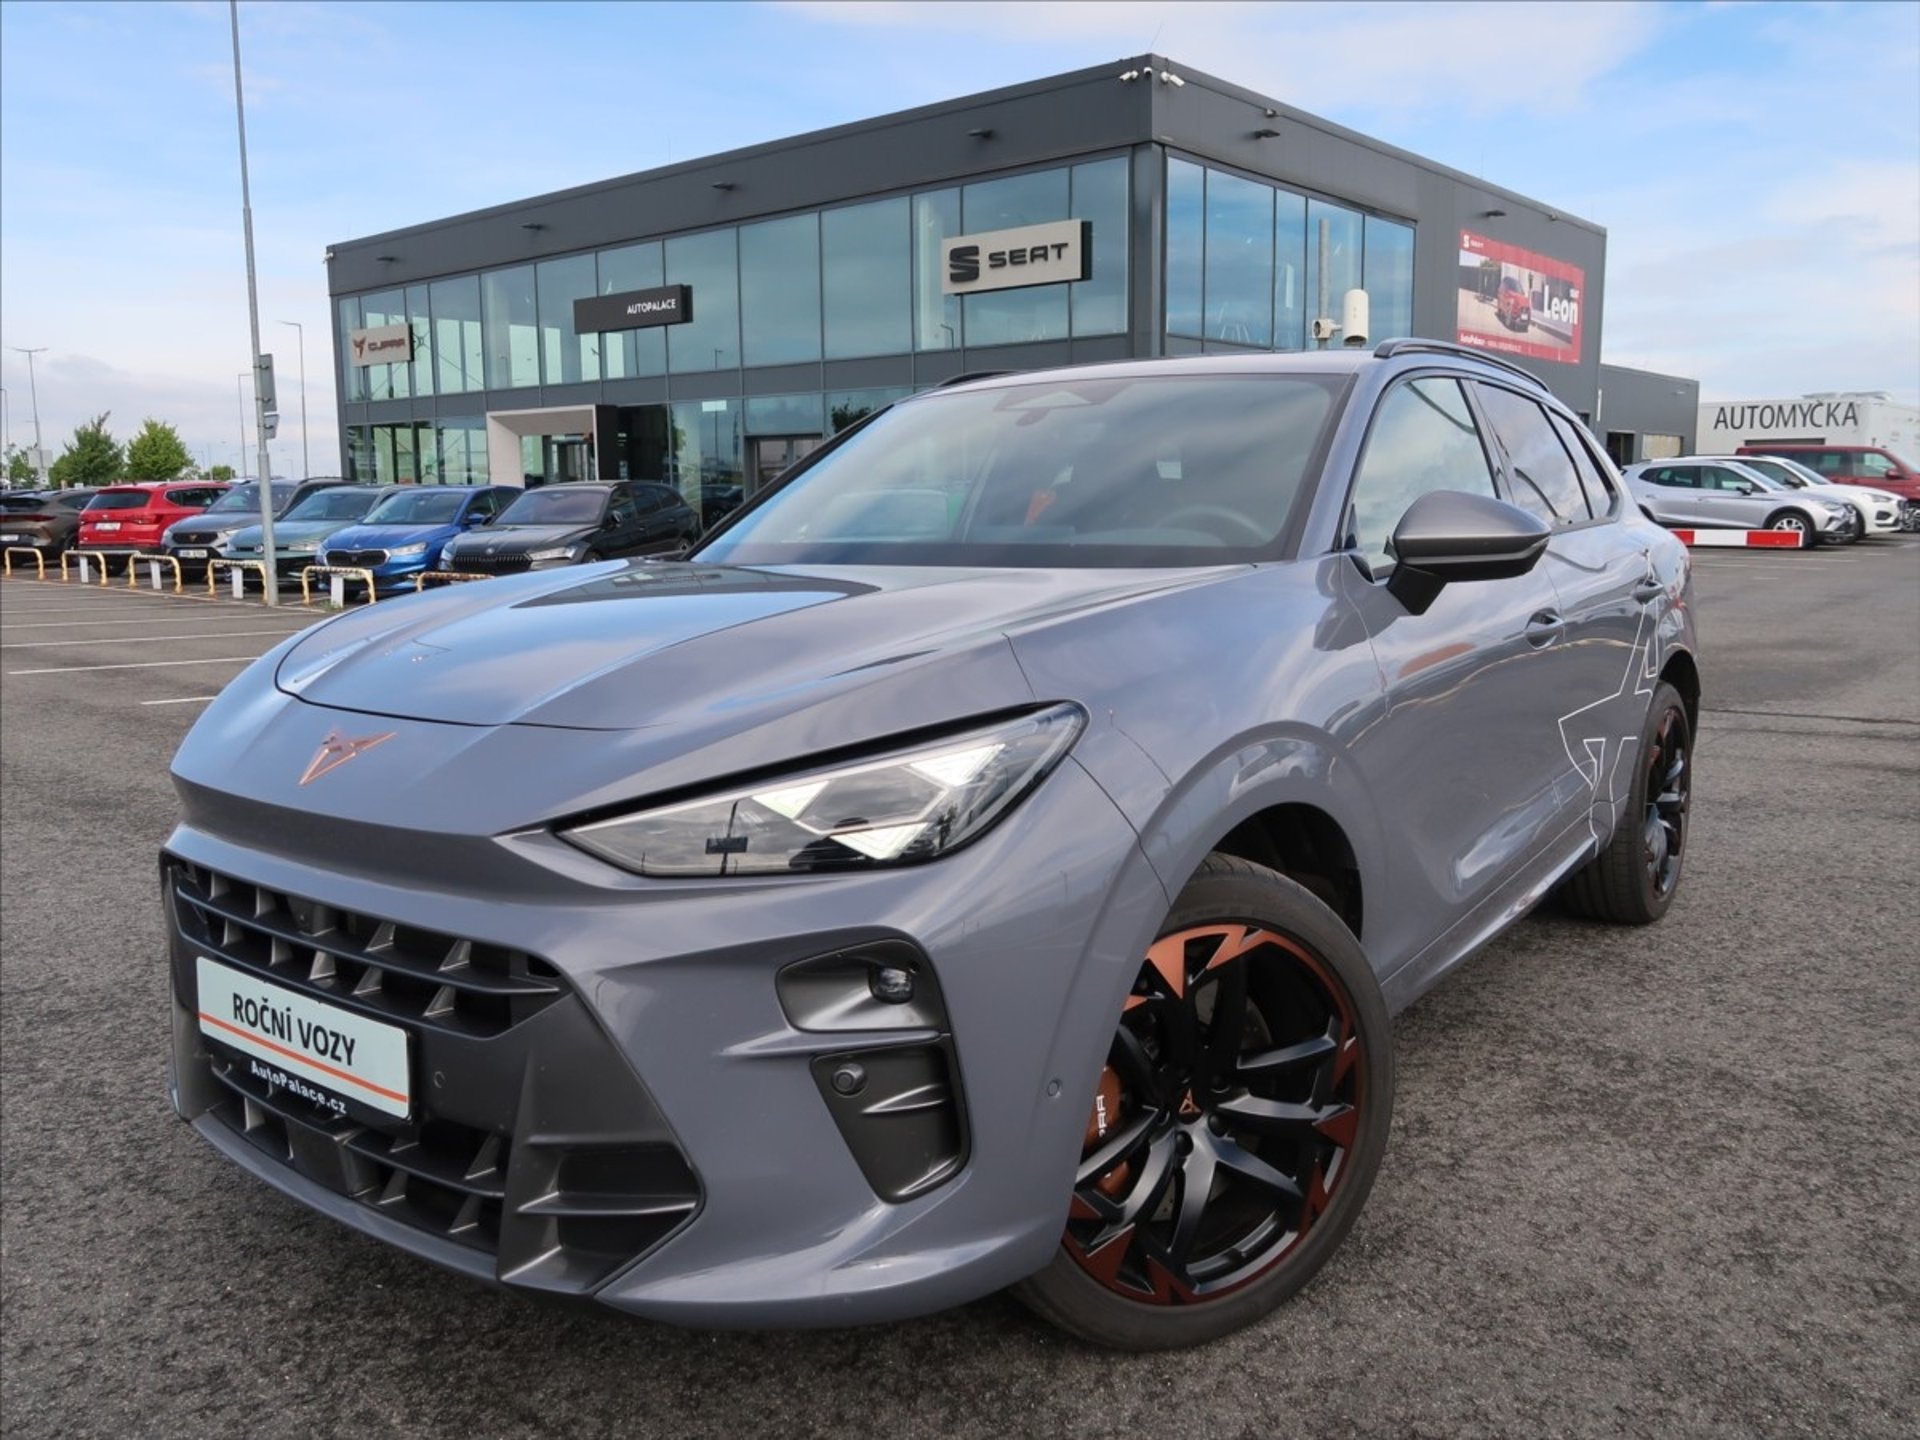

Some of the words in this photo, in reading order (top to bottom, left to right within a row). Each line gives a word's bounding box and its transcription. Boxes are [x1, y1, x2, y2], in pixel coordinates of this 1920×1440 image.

[988, 242, 1069, 269] SEAT
[626, 298, 677, 315] AUTOPALACE
[1543, 285, 1579, 325] Leon
[1713, 400, 1859, 430] AUTOMYČKA
[232, 992, 293, 1043] ROČNÍ
[297, 1018, 356, 1067] VOZY
[250, 1060, 348, 1115] AutoPalace.cz
